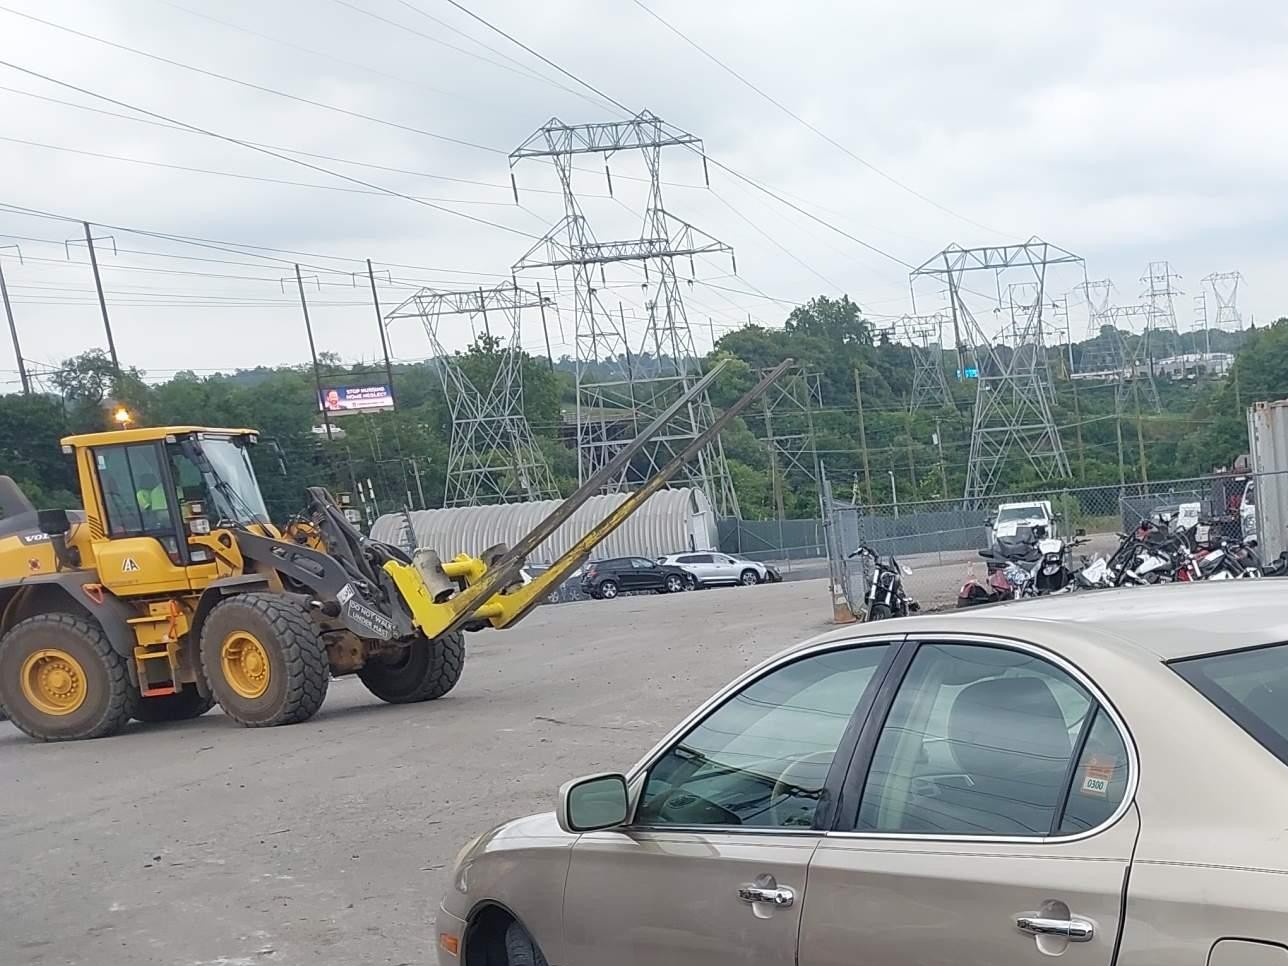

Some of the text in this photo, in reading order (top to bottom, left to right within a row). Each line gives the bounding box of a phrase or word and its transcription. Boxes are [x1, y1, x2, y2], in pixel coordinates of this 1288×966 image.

[350, 601, 361, 611] DO
[361, 606, 376, 619] NOT
[353, 612, 373, 627] UNDER
